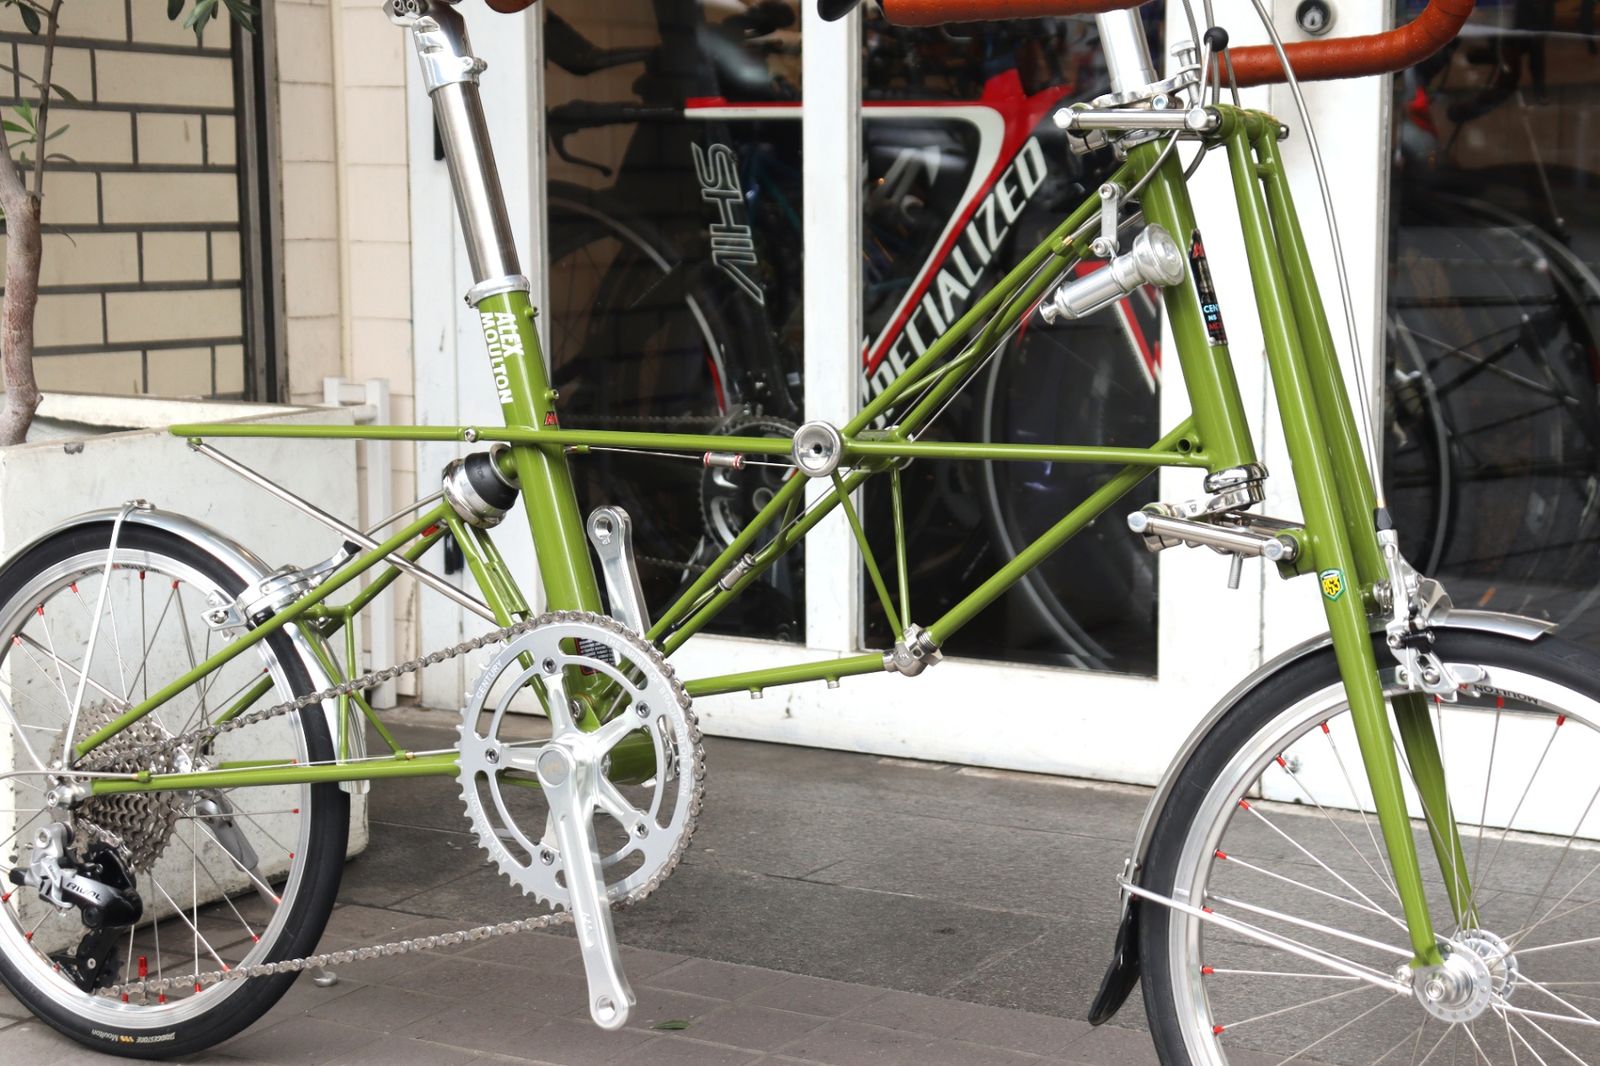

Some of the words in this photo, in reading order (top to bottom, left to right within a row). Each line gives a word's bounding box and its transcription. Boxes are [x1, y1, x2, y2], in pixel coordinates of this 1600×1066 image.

[690, 141, 765, 307] SHIV
[494, 311, 525, 358] ALEX
[480, 312, 514, 404] MOULTON
[1322, 576, 1341, 596] 853
[475, 659, 504, 699] CENTURY
[1474, 684, 1539, 705] MOULTON
[66, 882, 101, 901] RIVAL
